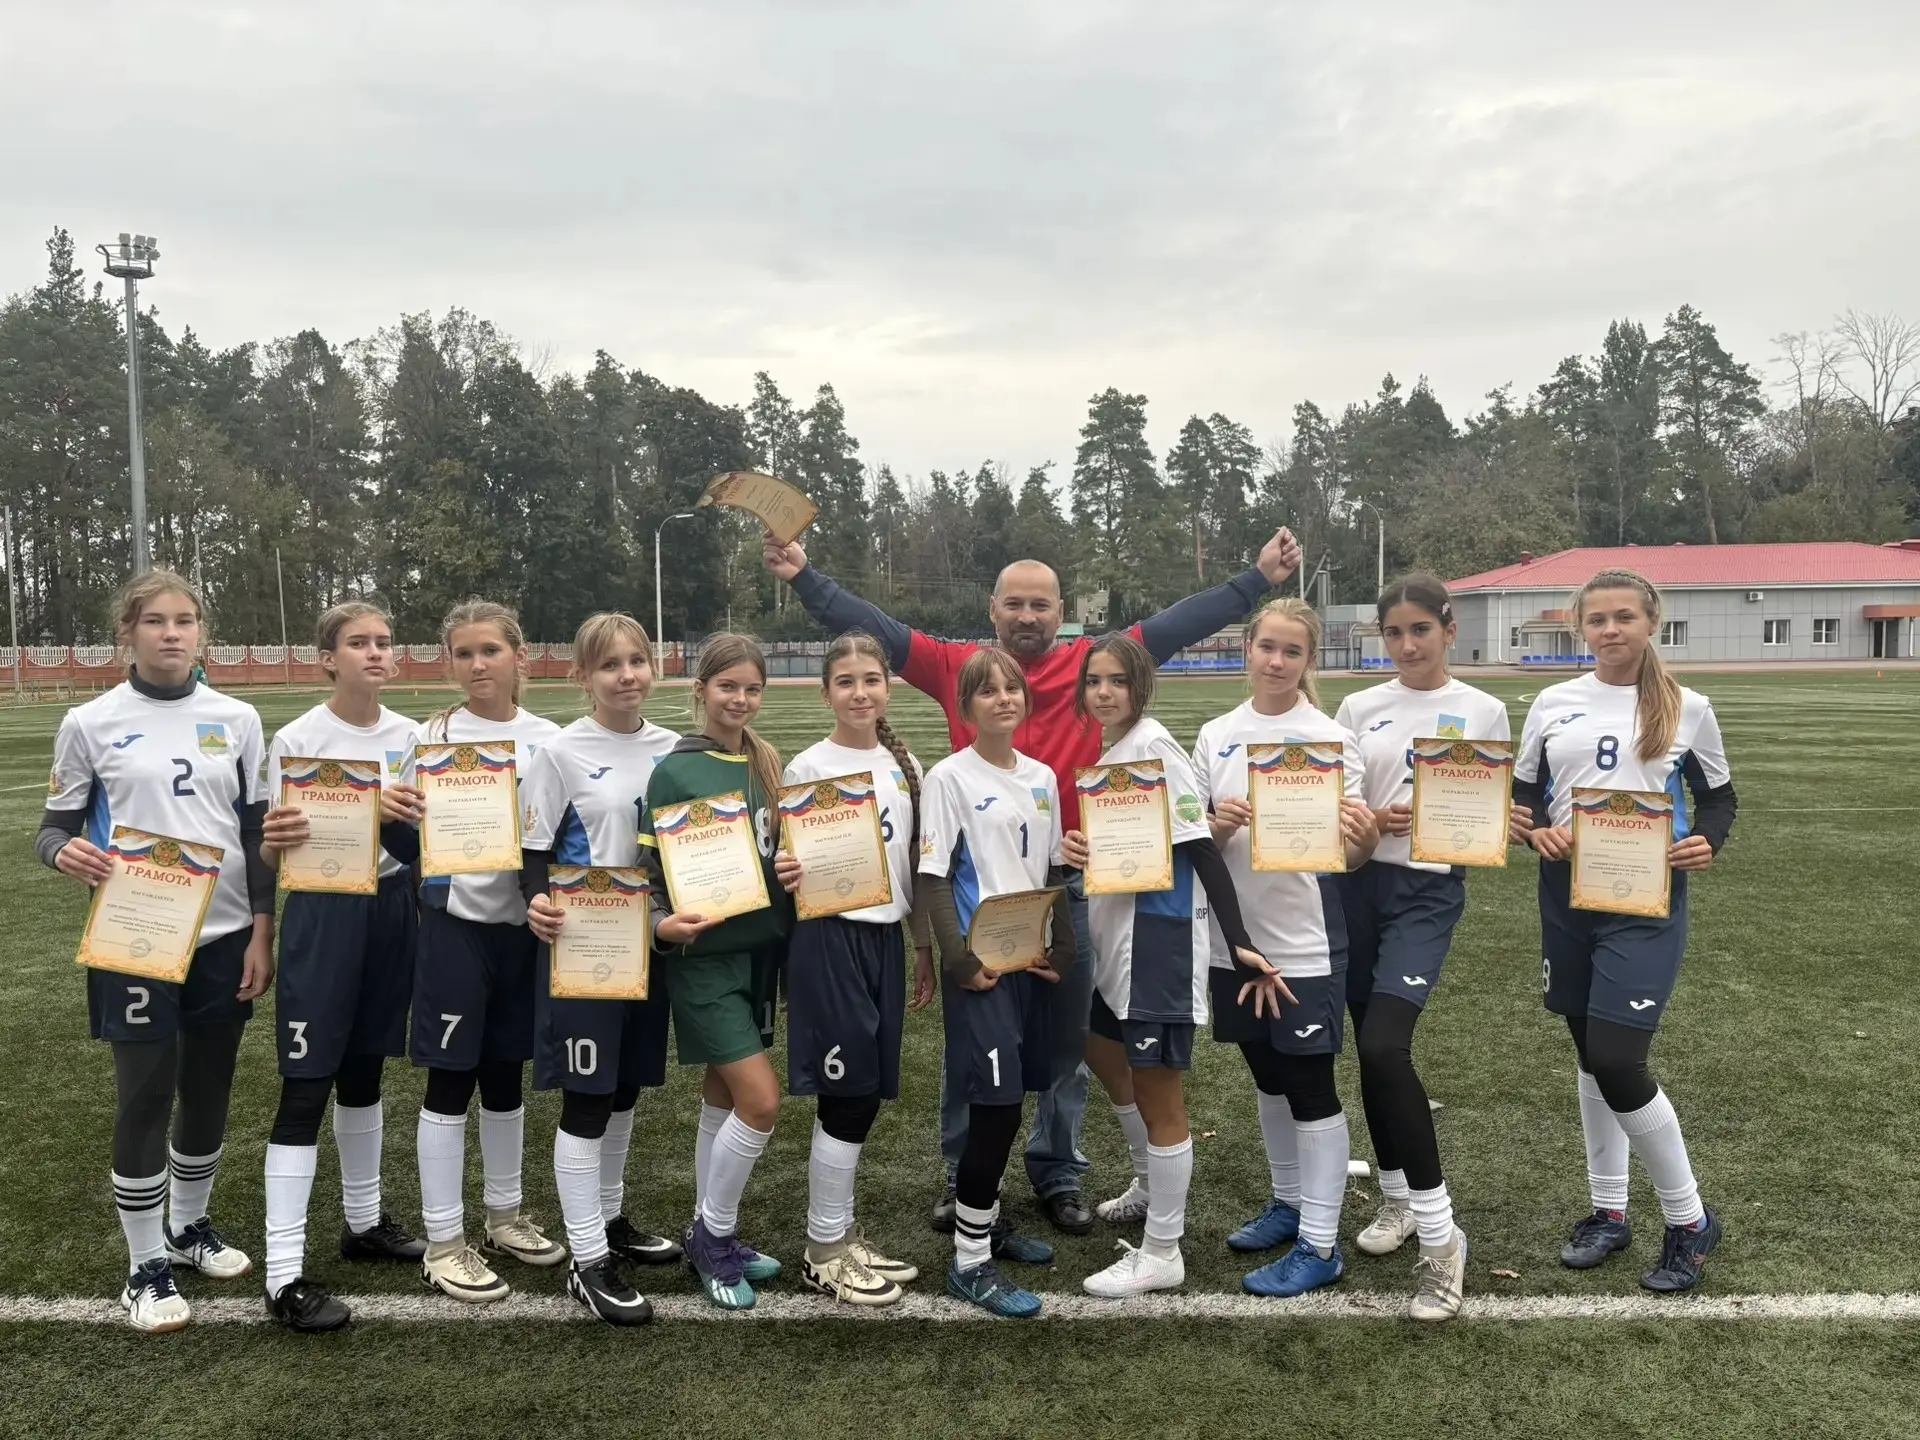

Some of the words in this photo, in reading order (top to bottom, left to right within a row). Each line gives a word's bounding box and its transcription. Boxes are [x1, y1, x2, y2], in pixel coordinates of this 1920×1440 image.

[1595, 735, 1620, 771] 8
[171, 758, 196, 797] 2
[436, 775, 498, 787] ГРАМОТА
[1267, 775, 1325, 786] ГРАМОТА
[1432, 767, 1492, 780] ГРАМОТА
[301, 791, 362, 803] ГРАМОТА
[1096, 794, 1150, 808] ГРАМОТА
[676, 825, 734, 846] ГРАМОТА
[801, 809, 860, 828] ГРАМОТА
[879, 806, 894, 843] 6
[1591, 817, 1652, 830] ГРАМОТА
[1019, 822, 1029, 859] 1
[125, 864, 193, 888] ГРАМОТА
[570, 897, 630, 907] ГРАМОТА
[1542, 957, 1551, 993] 8
[125, 986, 152, 1024] 2
[288, 1021, 309, 1060] 3
[440, 1013, 463, 1050] 7
[564, 1037, 598, 1076] 10
[824, 1044, 846, 1080] 6
[987, 1047, 1001, 1087] 1
